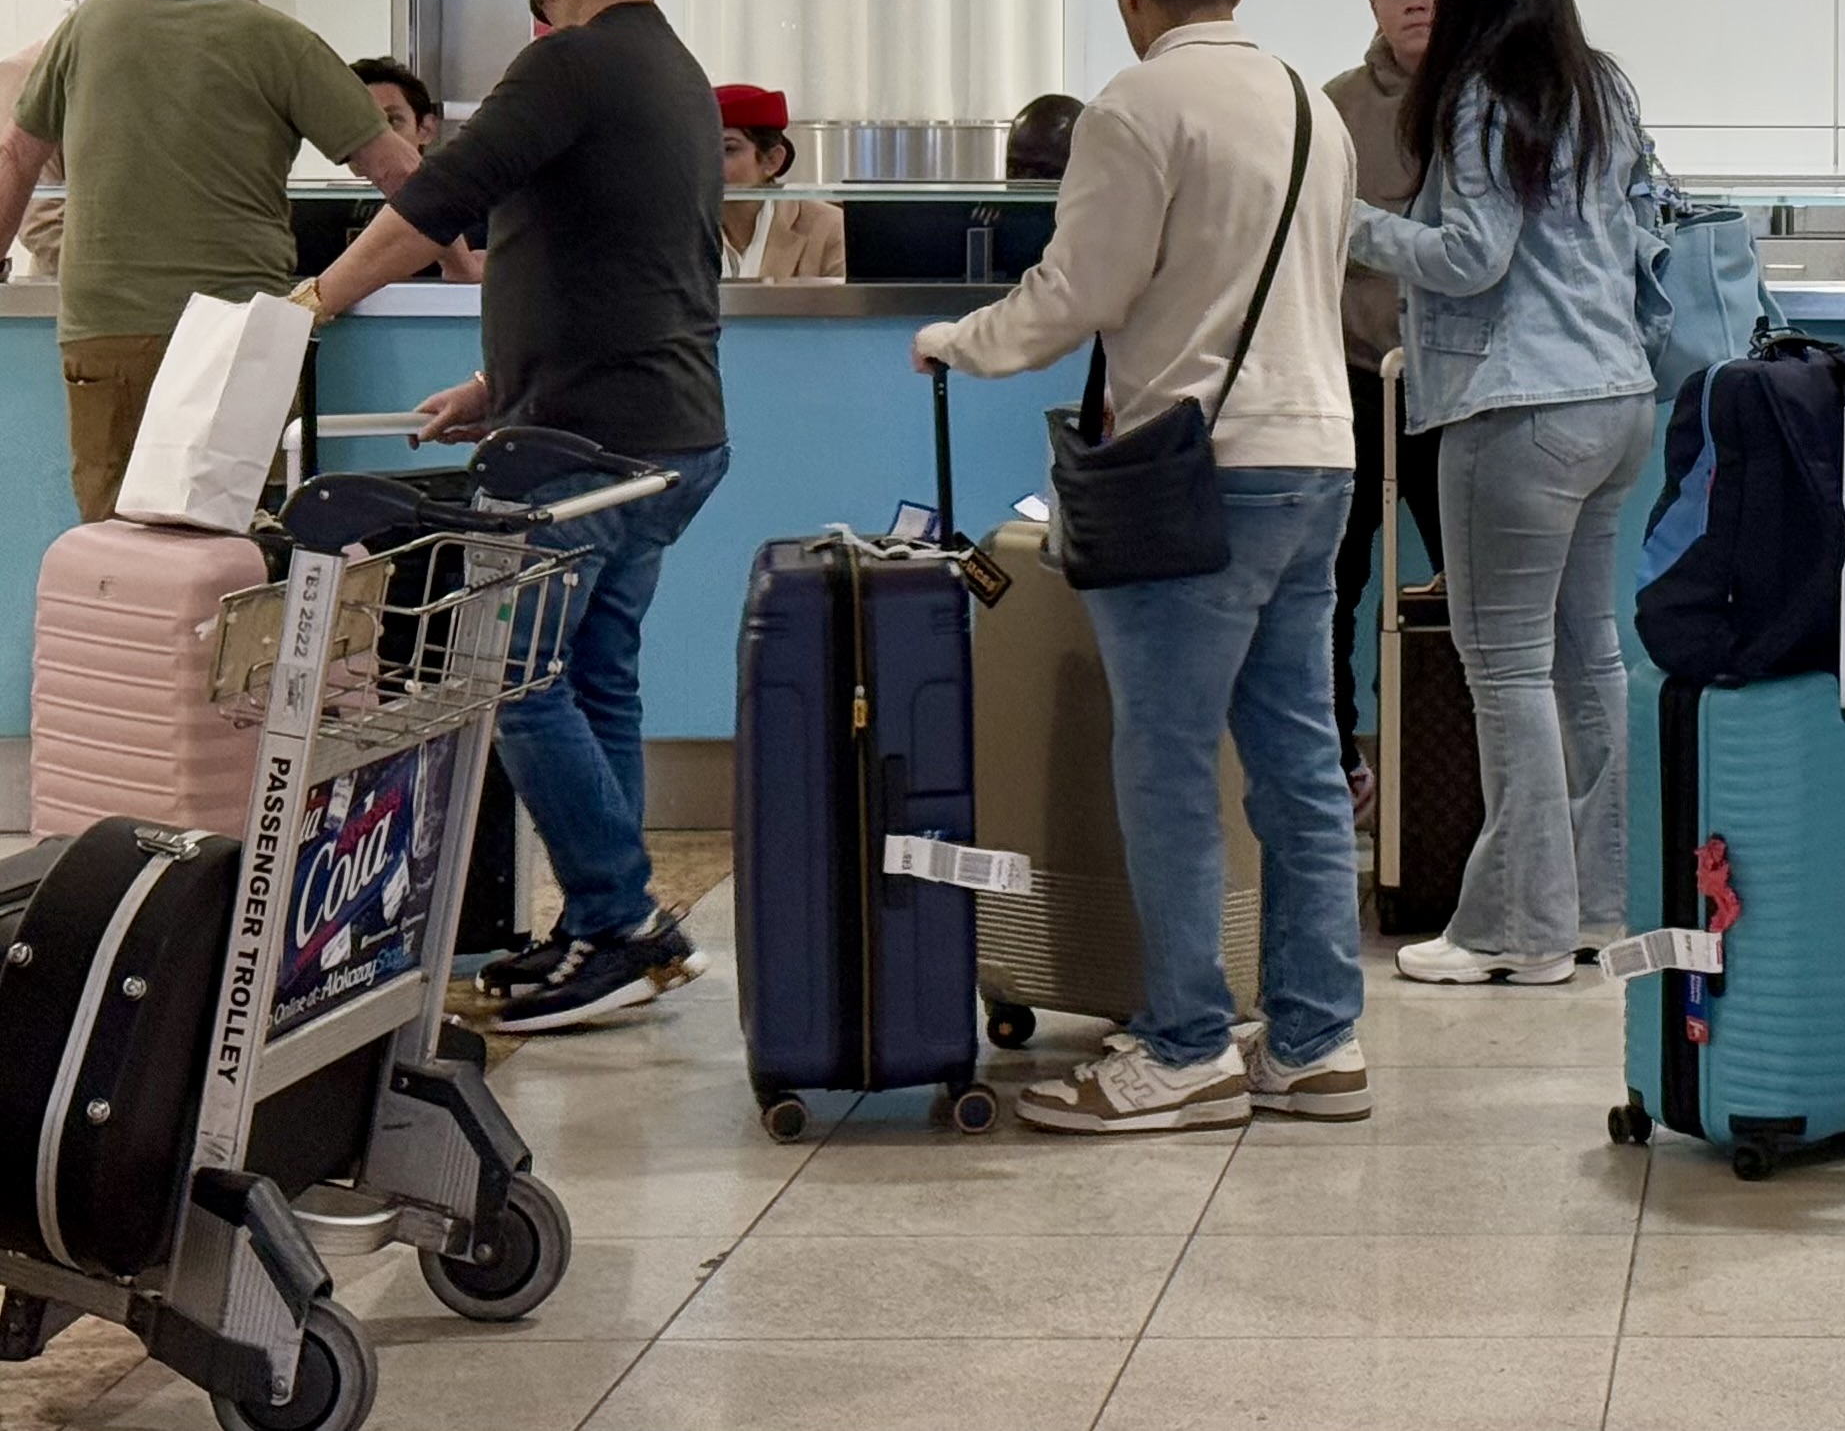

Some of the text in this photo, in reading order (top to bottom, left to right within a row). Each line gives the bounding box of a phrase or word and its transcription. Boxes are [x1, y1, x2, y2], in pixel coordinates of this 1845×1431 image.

[294, 607, 316, 659] 2522
[217, 756, 292, 1085] PASSENGER TROLLEY
[295, 809, 394, 949] Cola
